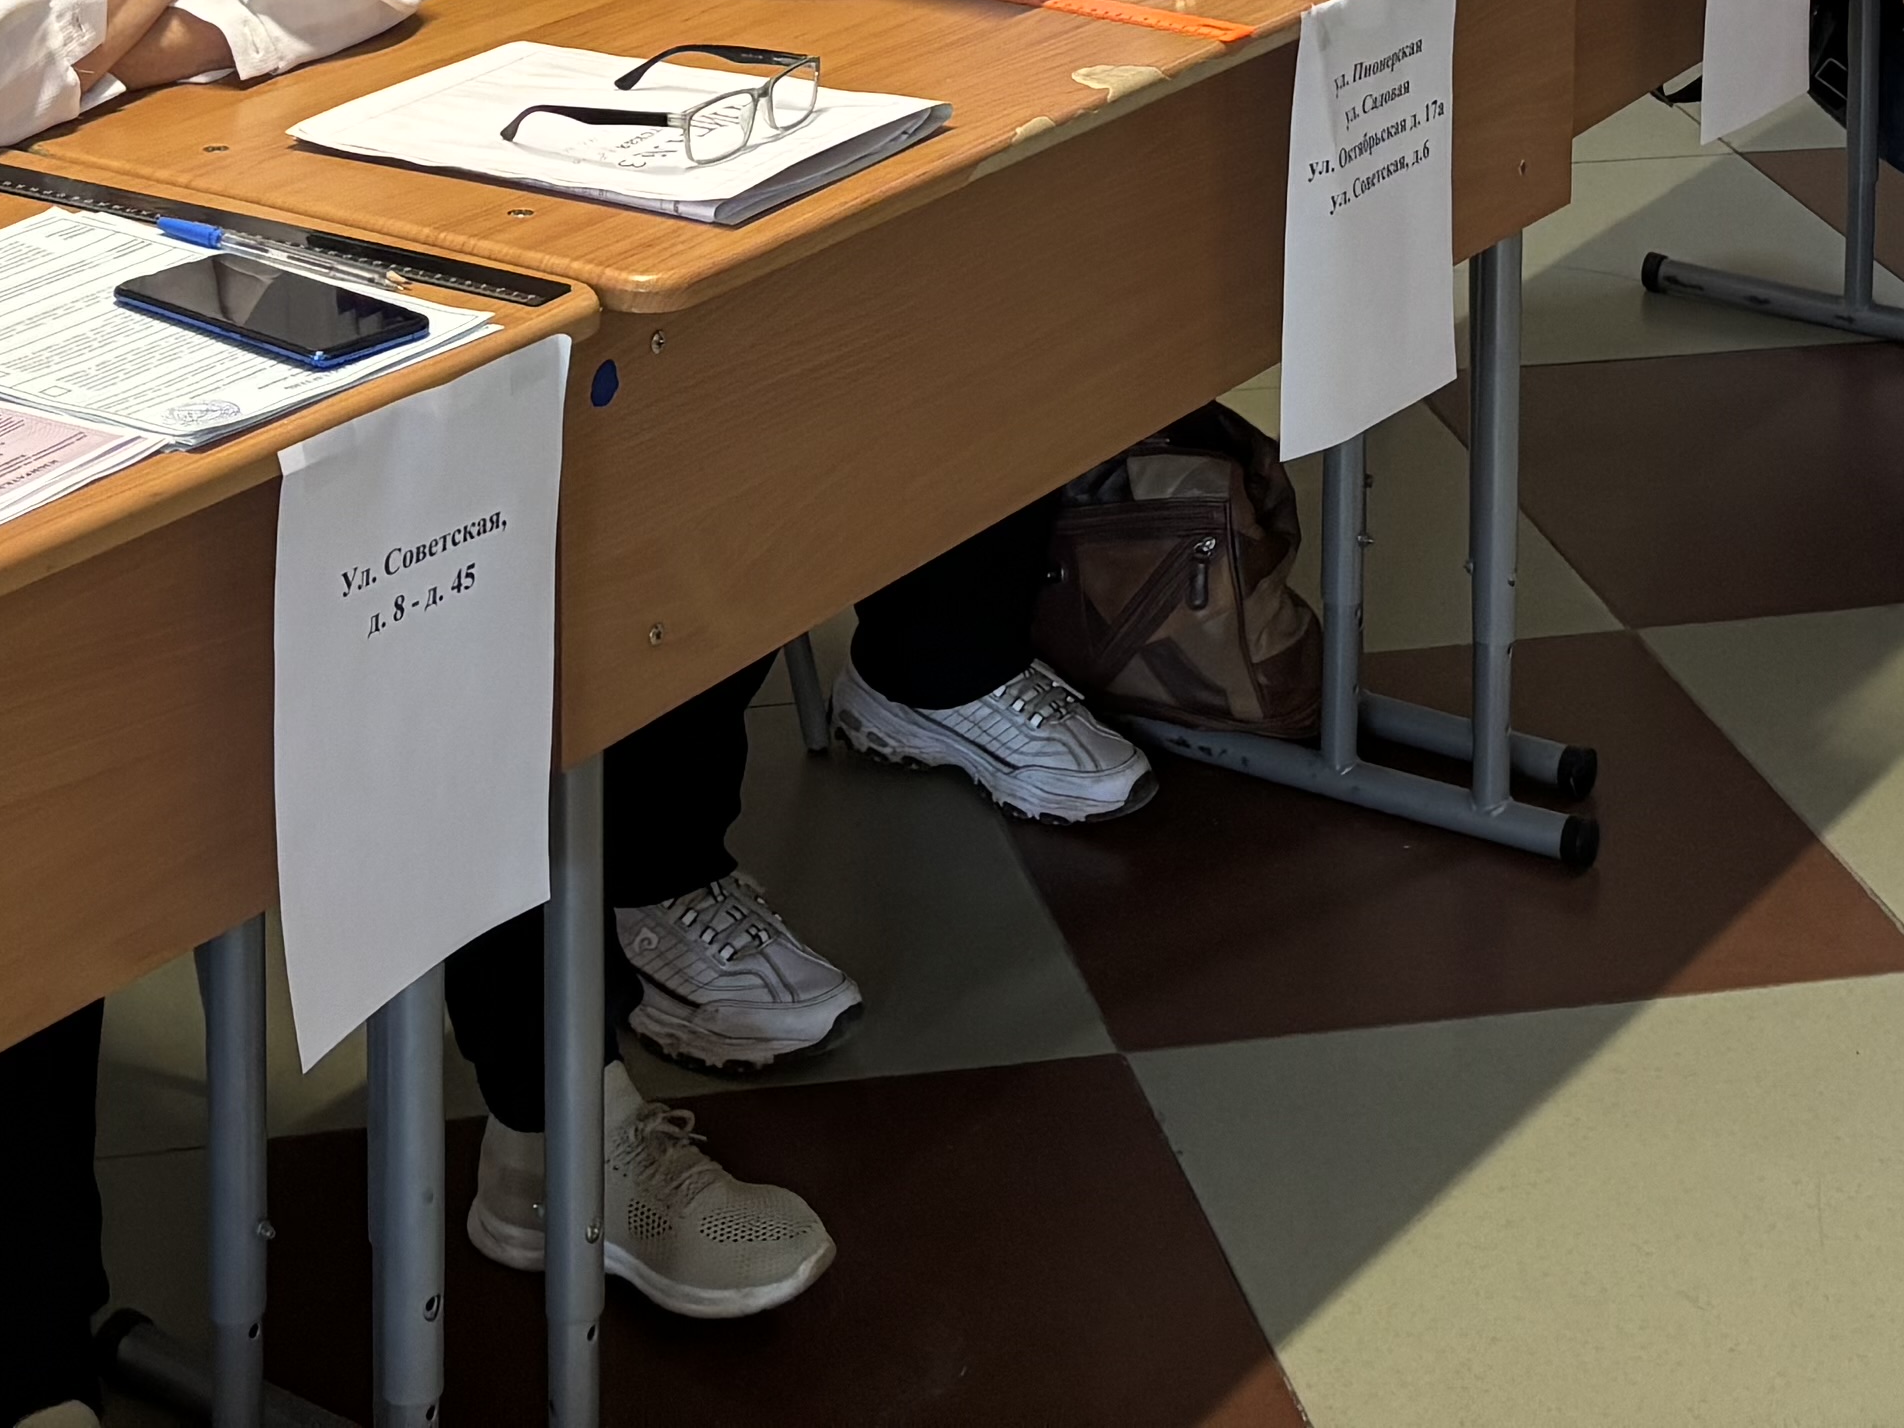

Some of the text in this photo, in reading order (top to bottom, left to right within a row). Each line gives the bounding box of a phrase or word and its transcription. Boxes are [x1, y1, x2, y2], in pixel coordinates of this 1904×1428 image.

[1353, 38, 1423, 83] Пионерская
[1362, 79, 1410, 115] Садовая
[1339, 118, 1407, 169] Октябрьская
[1352, 155, 1409, 200] Советская,
[341, 511, 507, 598] Ул. Советская,
[367, 609, 387, 640] д.
[393, 594, 405, 622] 8
[424, 582, 445, 613] д.
[450, 564, 477, 594] 45
